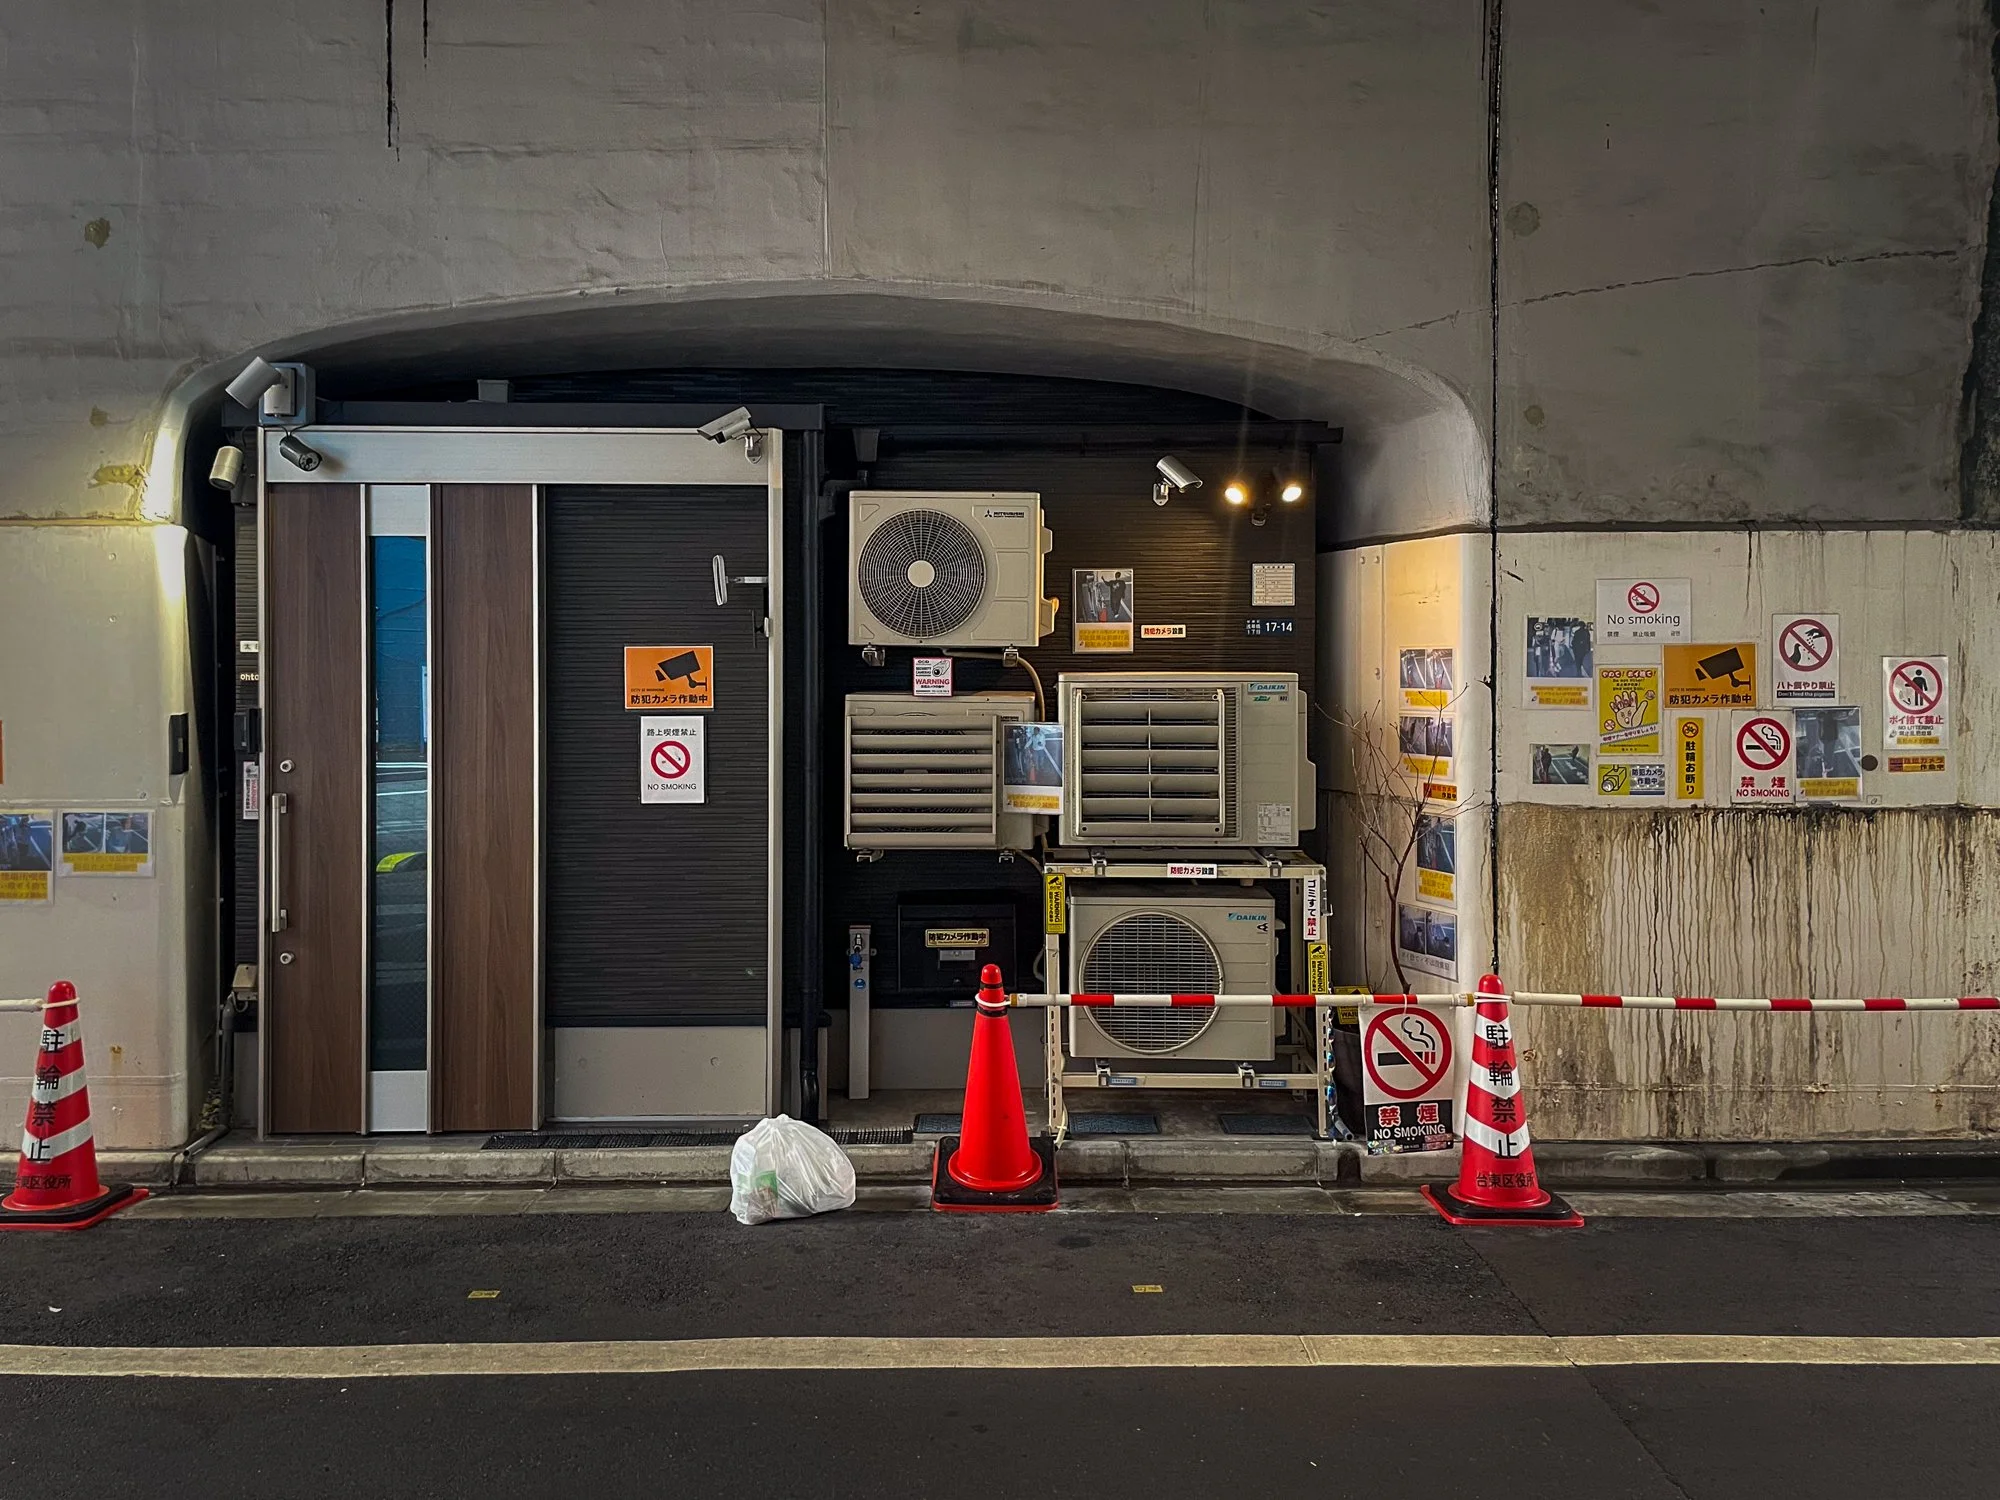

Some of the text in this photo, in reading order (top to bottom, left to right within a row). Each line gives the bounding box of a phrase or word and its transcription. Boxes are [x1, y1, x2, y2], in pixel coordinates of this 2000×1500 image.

[1607, 613, 1680, 627] No smoking
[1265, 622, 1293, 632] 17-14
[631, 693, 708, 704] 防犯カメラ作動中
[1669, 694, 1752, 705] 防犯カメラ作動中
[1889, 715, 1945, 725] ポイ捨て禁止
[646, 728, 697, 737] 路上喫煙禁止
[1632, 768, 1663, 776] 防犯カメラ
[1685, 741, 1696, 795] 駐輪お断り
[661, 783, 697, 791] SMOKING
[1741, 776, 1786, 789] 禁煙
[1736, 789, 1790, 797] NO SMOKING
[1170, 867, 1215, 875] 防犯カメラ設置
[1307, 879, 1317, 936] ゴミすて禁止
[27, 1029, 66, 1163] 駐輪禁止
[1485, 1024, 1520, 1159] 駐輪禁止
[1379, 1103, 1439, 1127] 禁煙
[1374, 1124, 1446, 1139] NO SMOKING
[1476, 1173, 1535, 1189] 台東区役所
